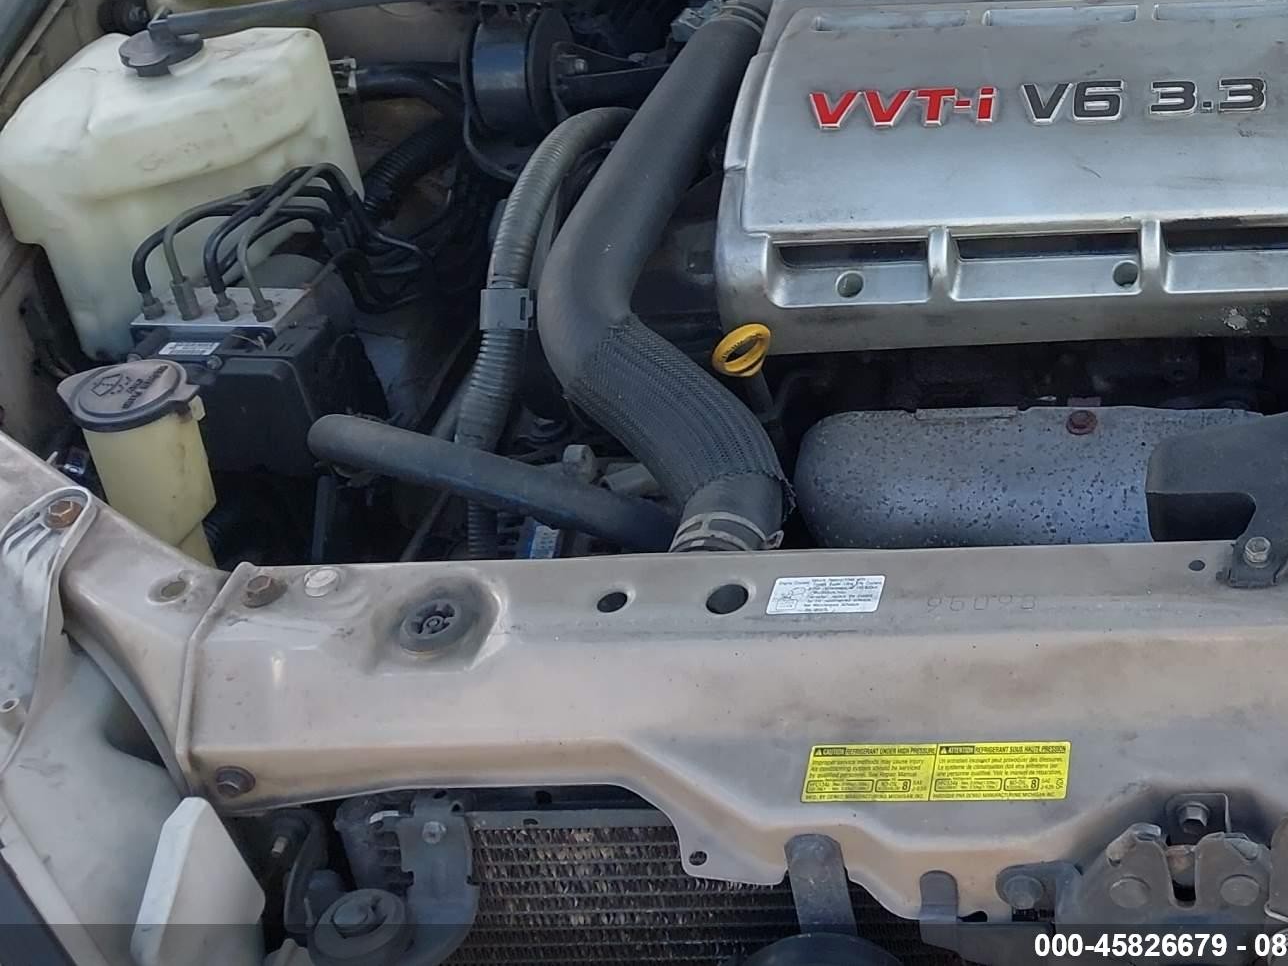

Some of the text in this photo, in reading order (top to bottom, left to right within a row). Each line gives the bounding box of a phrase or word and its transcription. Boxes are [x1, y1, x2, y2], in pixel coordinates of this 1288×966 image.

[809, 77, 1266, 129] VVT-i V6 3.3
